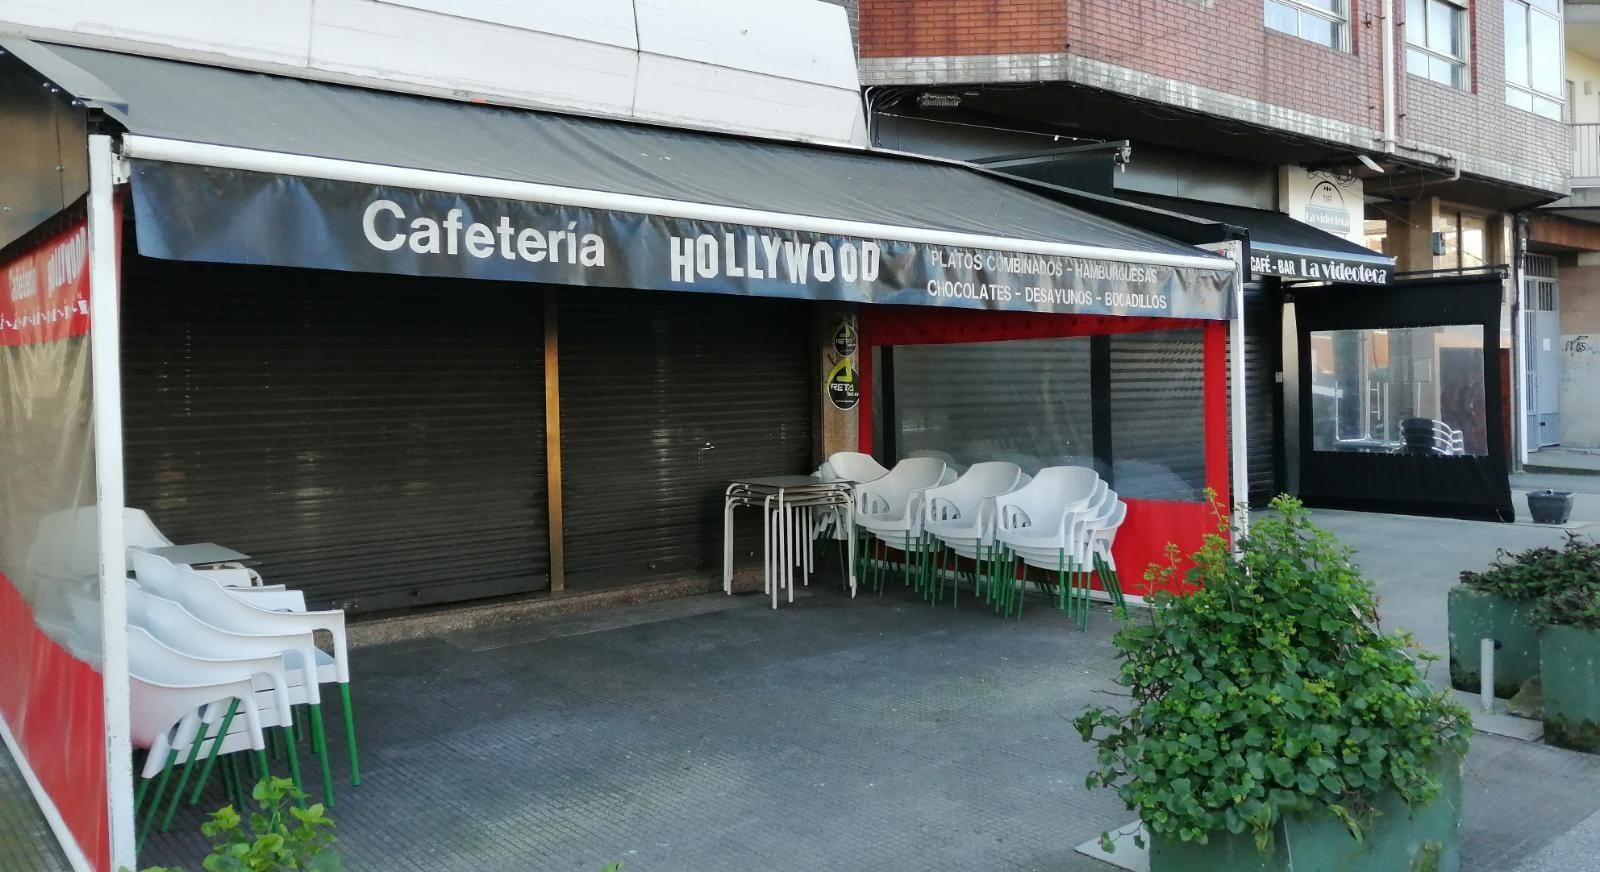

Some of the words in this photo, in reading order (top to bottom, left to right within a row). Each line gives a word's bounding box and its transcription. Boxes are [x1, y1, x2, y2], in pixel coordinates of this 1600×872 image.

[362, 199, 606, 267] Cafetería
[670, 233, 881, 285] HOLLYWOOD
[931, 250, 983, 271] PLATOS
[986, 254, 1063, 277] COMBINADOS
[1075, 262, 1158, 284] HAMBURGUESAS
[1250, 254, 1271, 273] CAFÉ
[1277, 259, 1296, 275] BAR
[1300, 258, 1320, 278] La
[1321, 260, 1387, 284] videoteca
[927, 279, 1012, 301] CHOCOLATES
[1025, 286, 1093, 305] DESAYUNOS
[1104, 292, 1167, 309] BOCADILLOS
